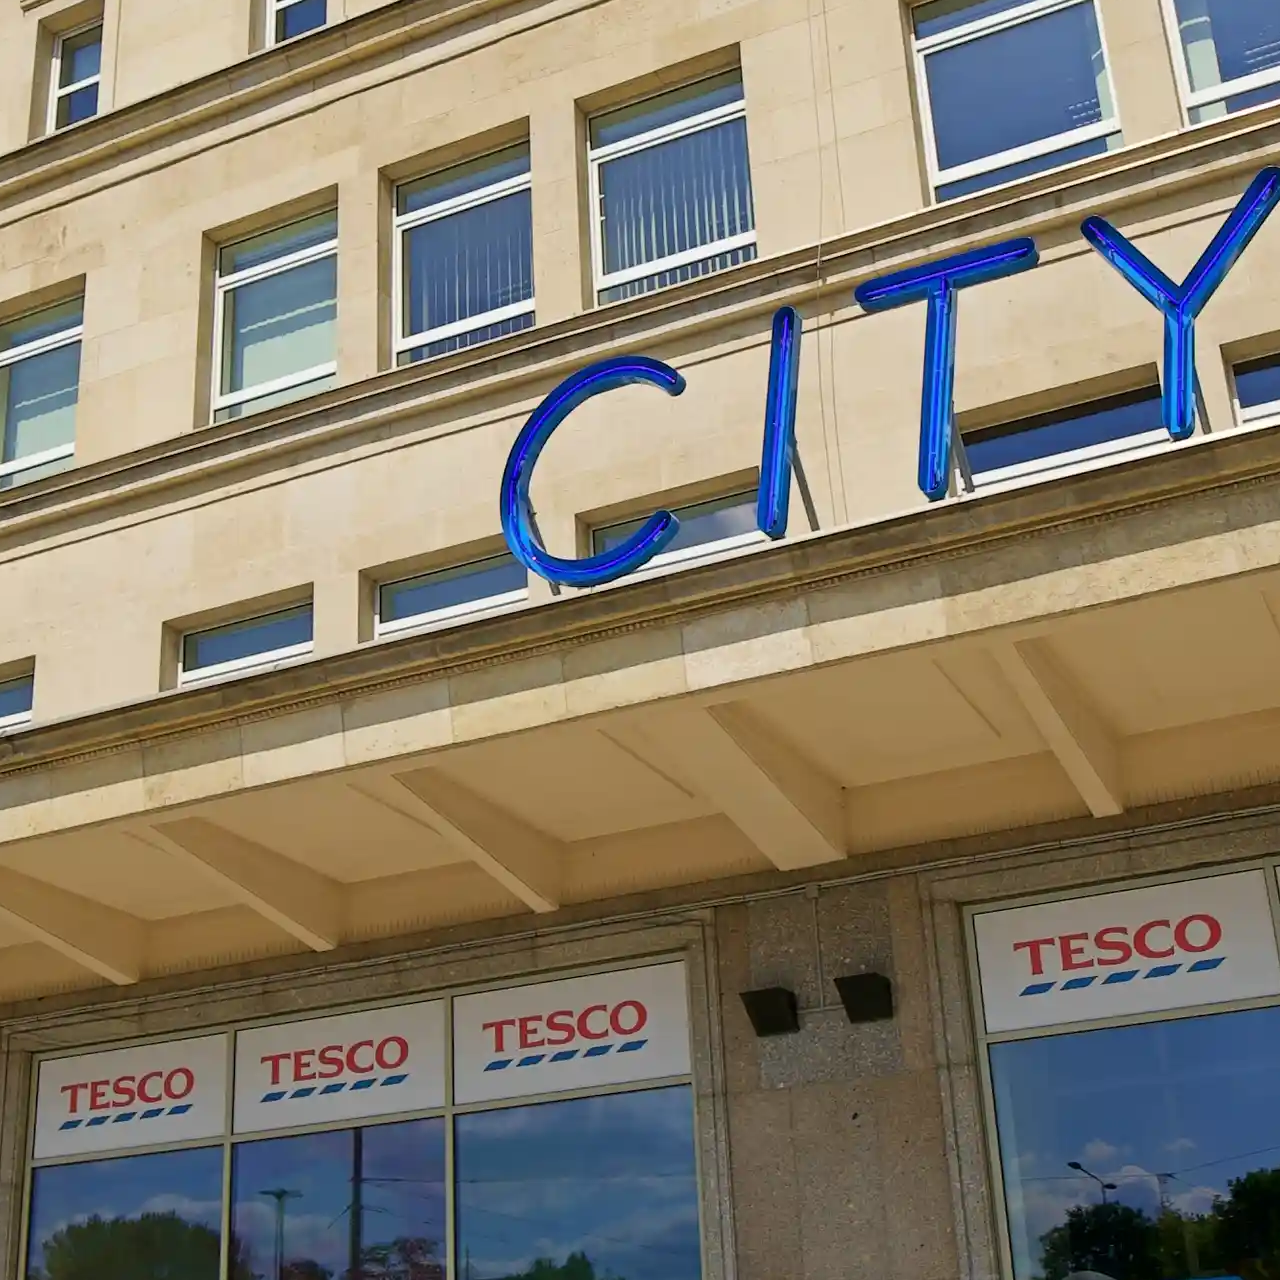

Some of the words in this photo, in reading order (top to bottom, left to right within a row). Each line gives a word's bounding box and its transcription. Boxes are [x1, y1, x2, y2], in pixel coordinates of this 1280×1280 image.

[1014, 913, 1223, 975] TESCO
[483, 1000, 648, 1052] TESCO
[261, 1036, 409, 1083] TESCO
[61, 1067, 195, 1113] TESCO
